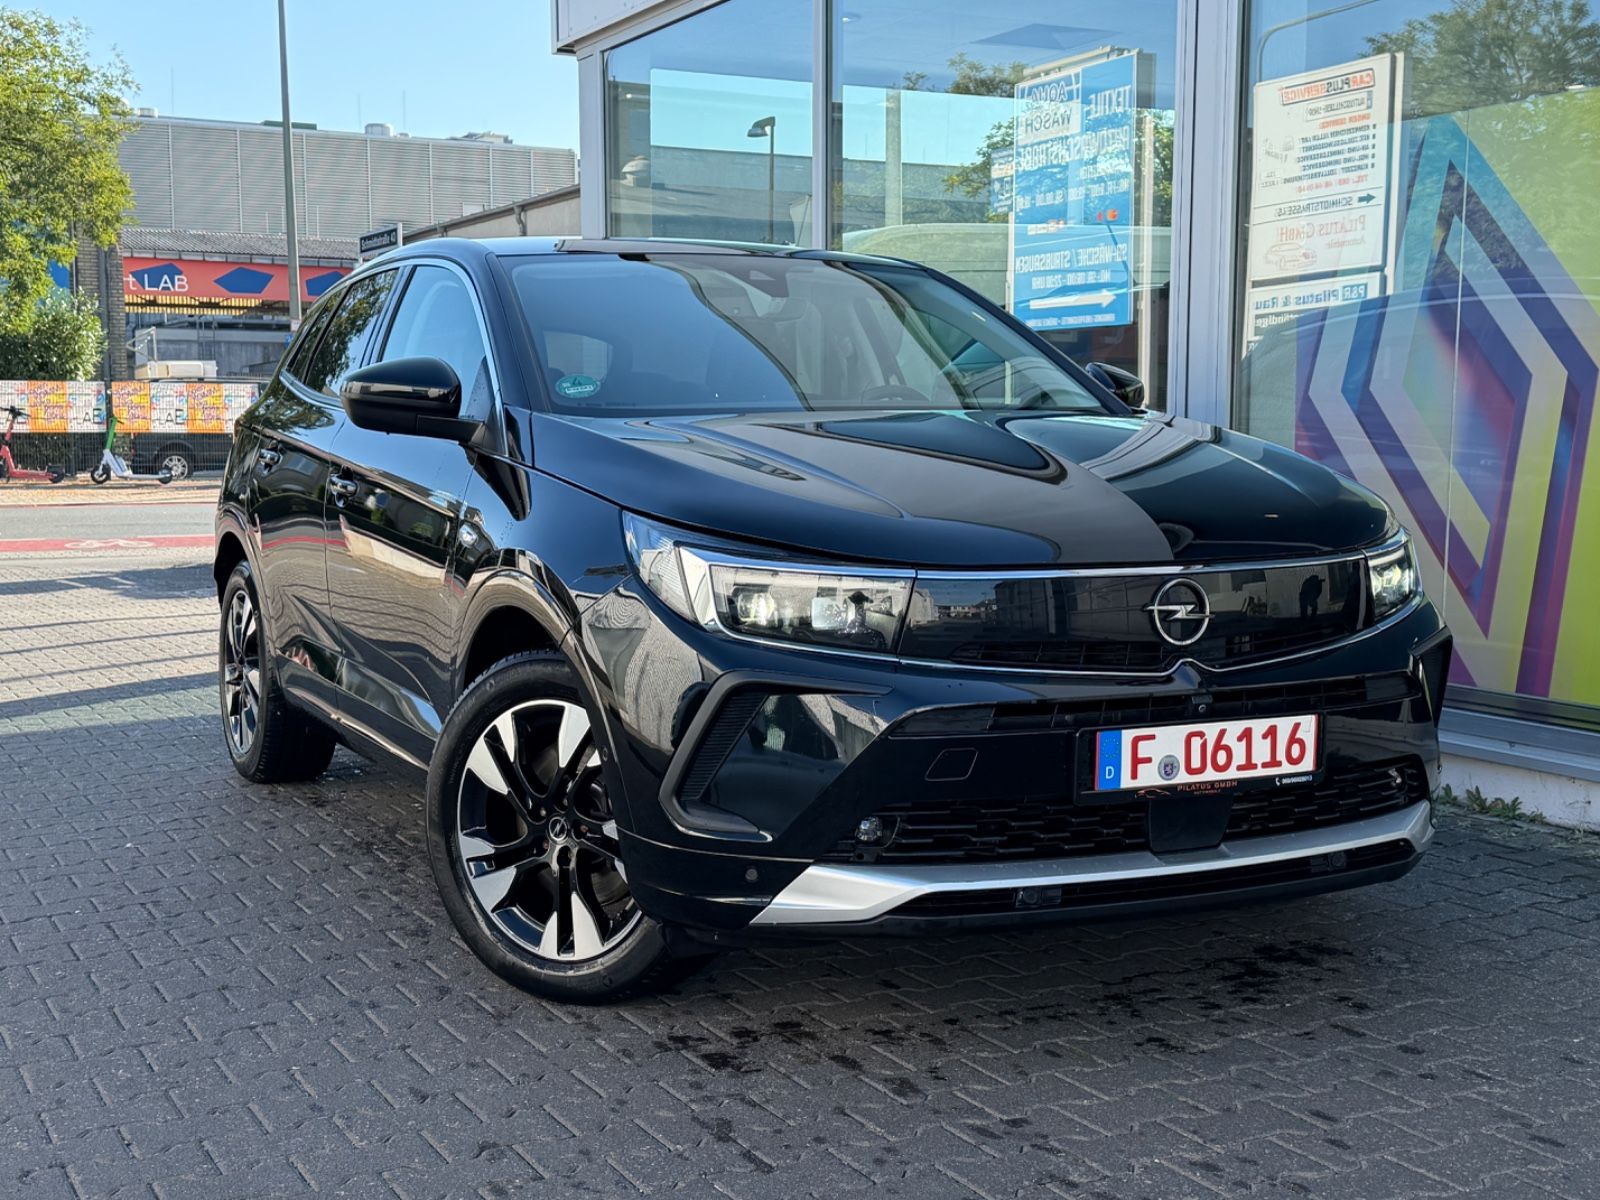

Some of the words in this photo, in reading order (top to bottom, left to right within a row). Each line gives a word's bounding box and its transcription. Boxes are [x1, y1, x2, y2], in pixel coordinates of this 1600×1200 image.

[144, 273, 189, 292] LAB
[1105, 765, 1115, 780] D
[1130, 734, 1157, 780] F
[1183, 722, 1307, 776] 06116
[1176, 782, 1211, 792] PILATUS
